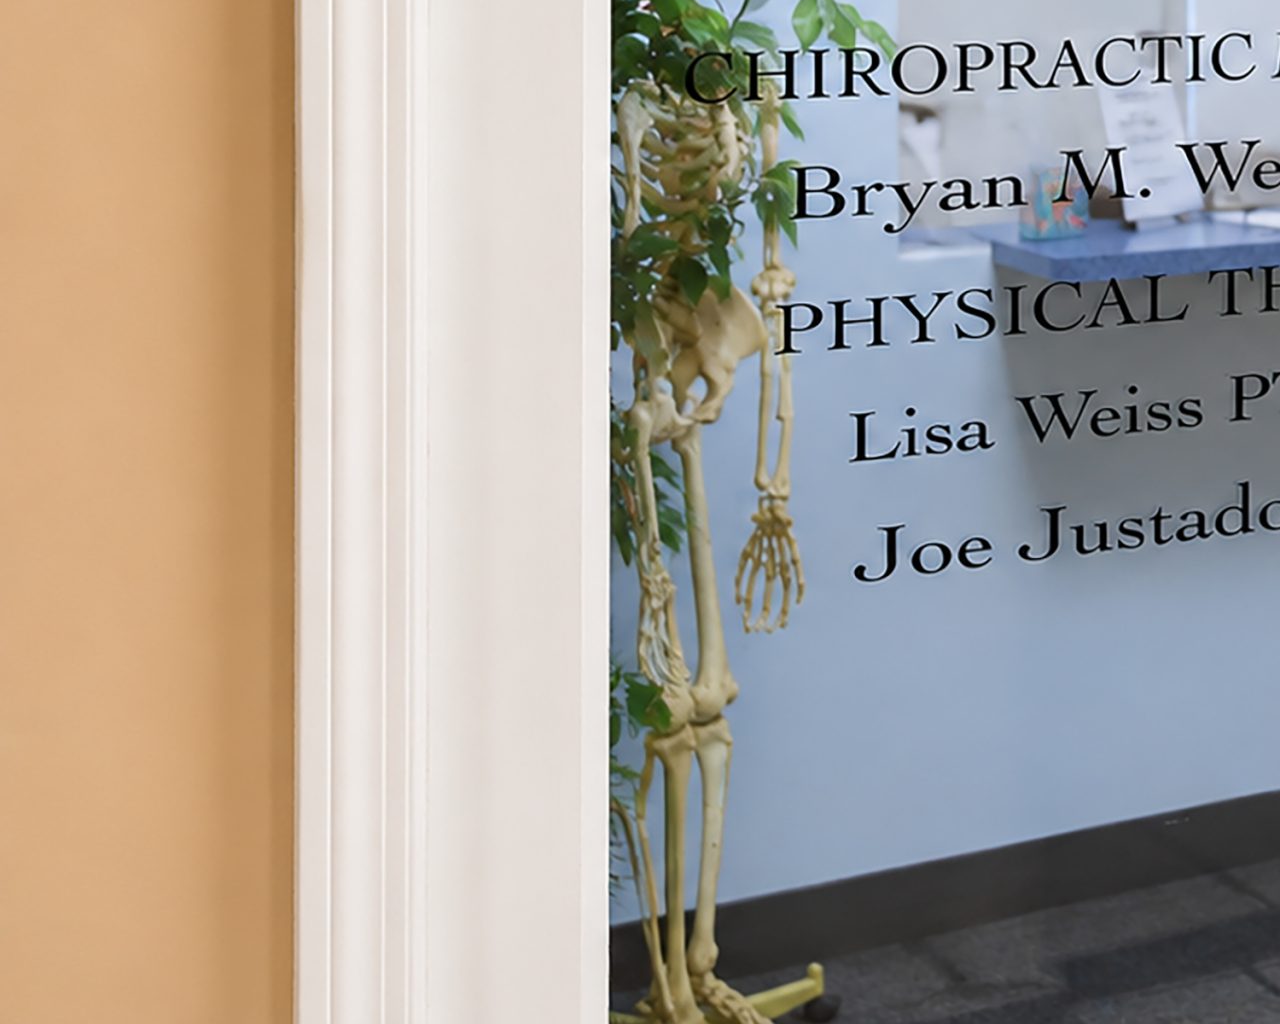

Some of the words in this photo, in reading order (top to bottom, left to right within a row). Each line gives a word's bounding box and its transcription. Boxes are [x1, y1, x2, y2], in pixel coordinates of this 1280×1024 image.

[684, 32, 1257, 105] CHIROPRACTIC
[791, 164, 1027, 235] Bryan
[1052, 148, 1152, 204] M.
[775, 278, 1190, 355] PHYSICAL
[849, 411, 995, 464] Lisa
[1018, 384, 1203, 445] Weiss
[853, 524, 994, 585] Joe
